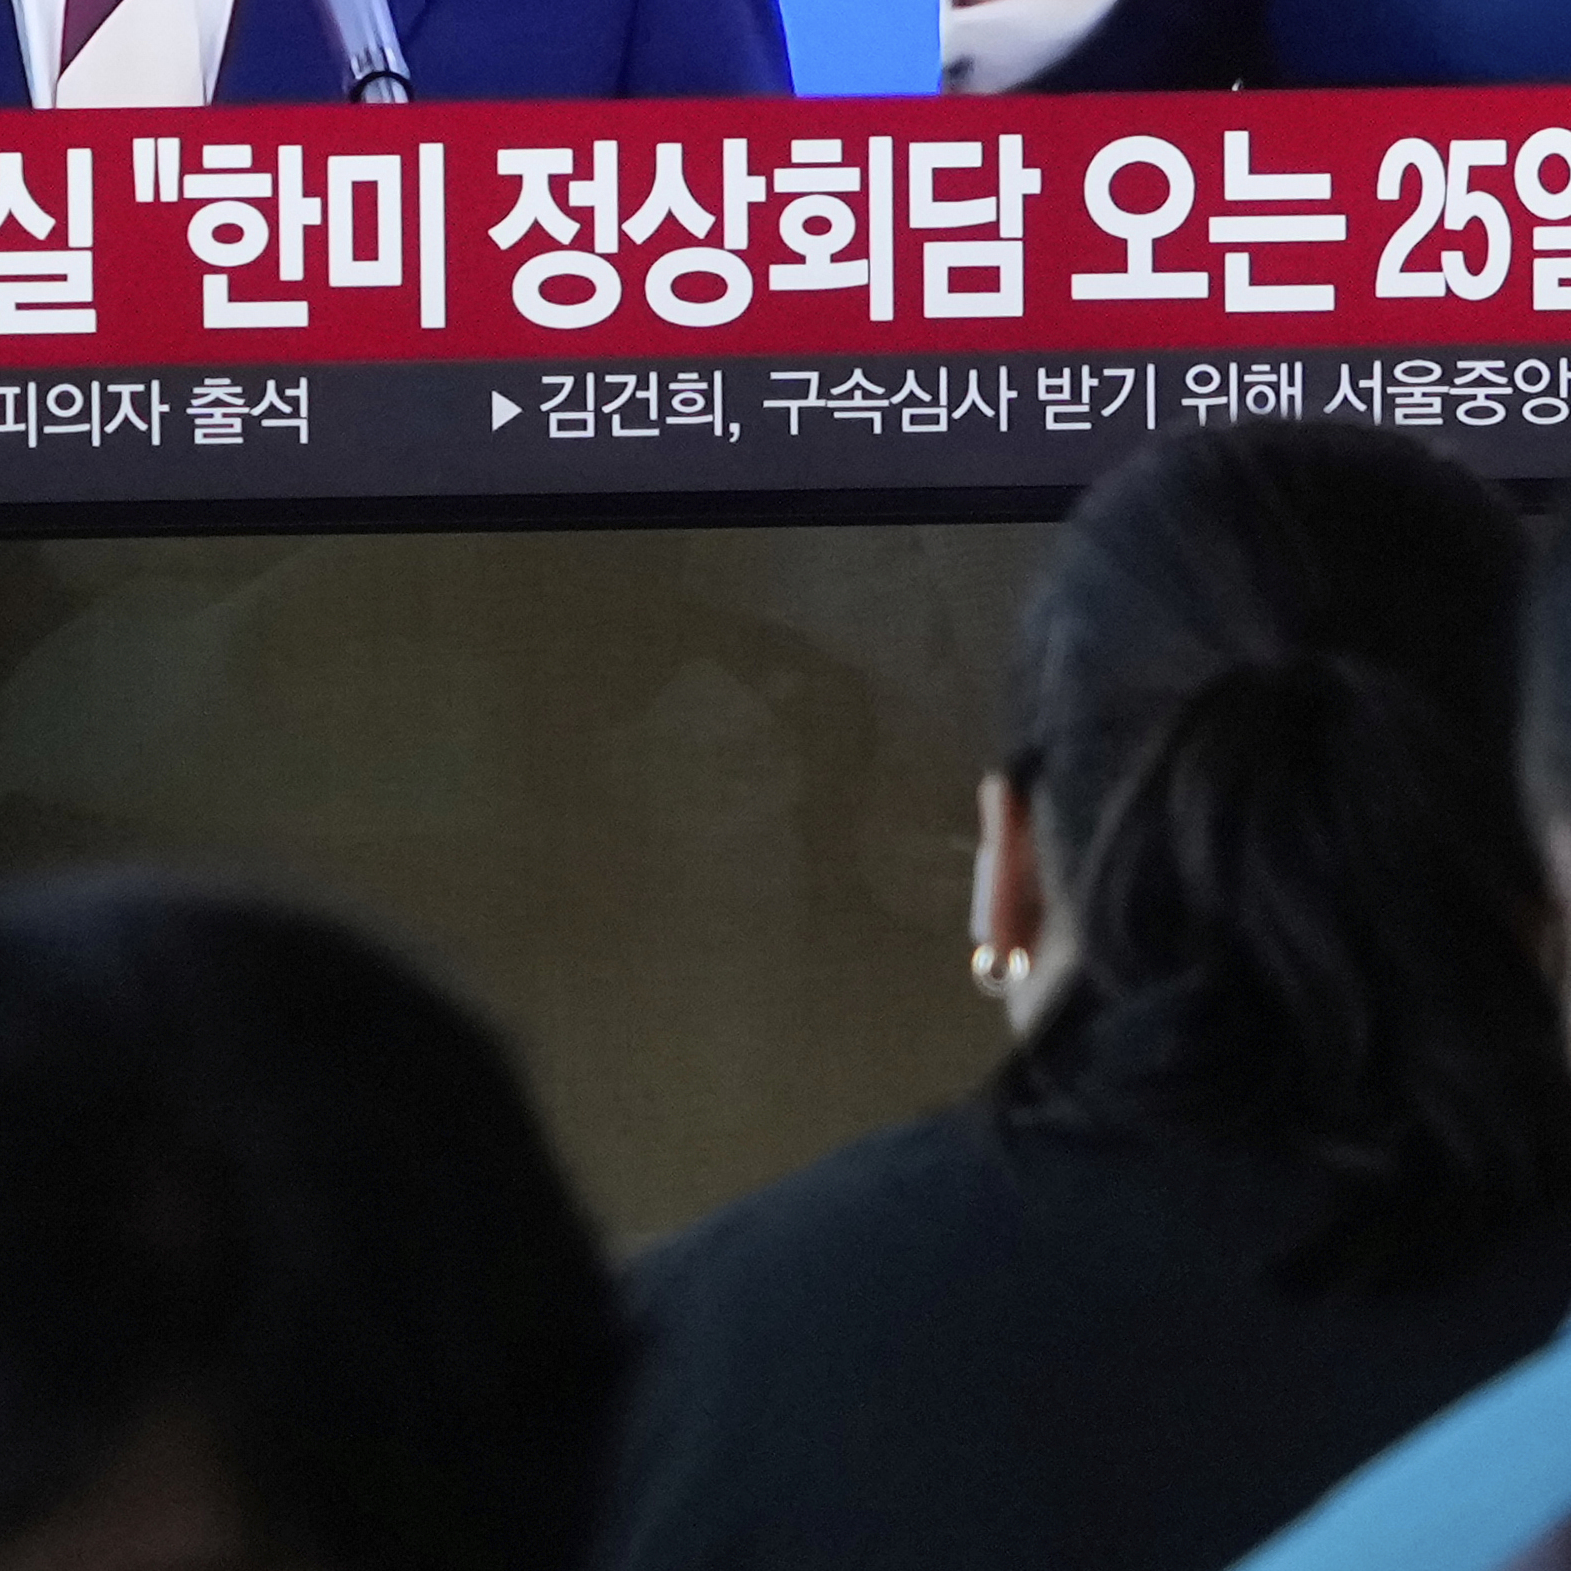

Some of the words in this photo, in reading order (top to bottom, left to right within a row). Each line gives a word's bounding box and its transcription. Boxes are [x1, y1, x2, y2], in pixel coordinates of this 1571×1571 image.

[132, 137, 446, 329] "한미
[488, 134, 1042, 329] 정상회담
[1071, 130, 1347, 313] 오는
[185, 376, 309, 445] 출석
[539, 369, 741, 443] 김건희,
[762, 365, 1018, 436] 구속심사
[1037, 363, 1156, 431] 받기
[1181, 360, 1303, 427] 위해
